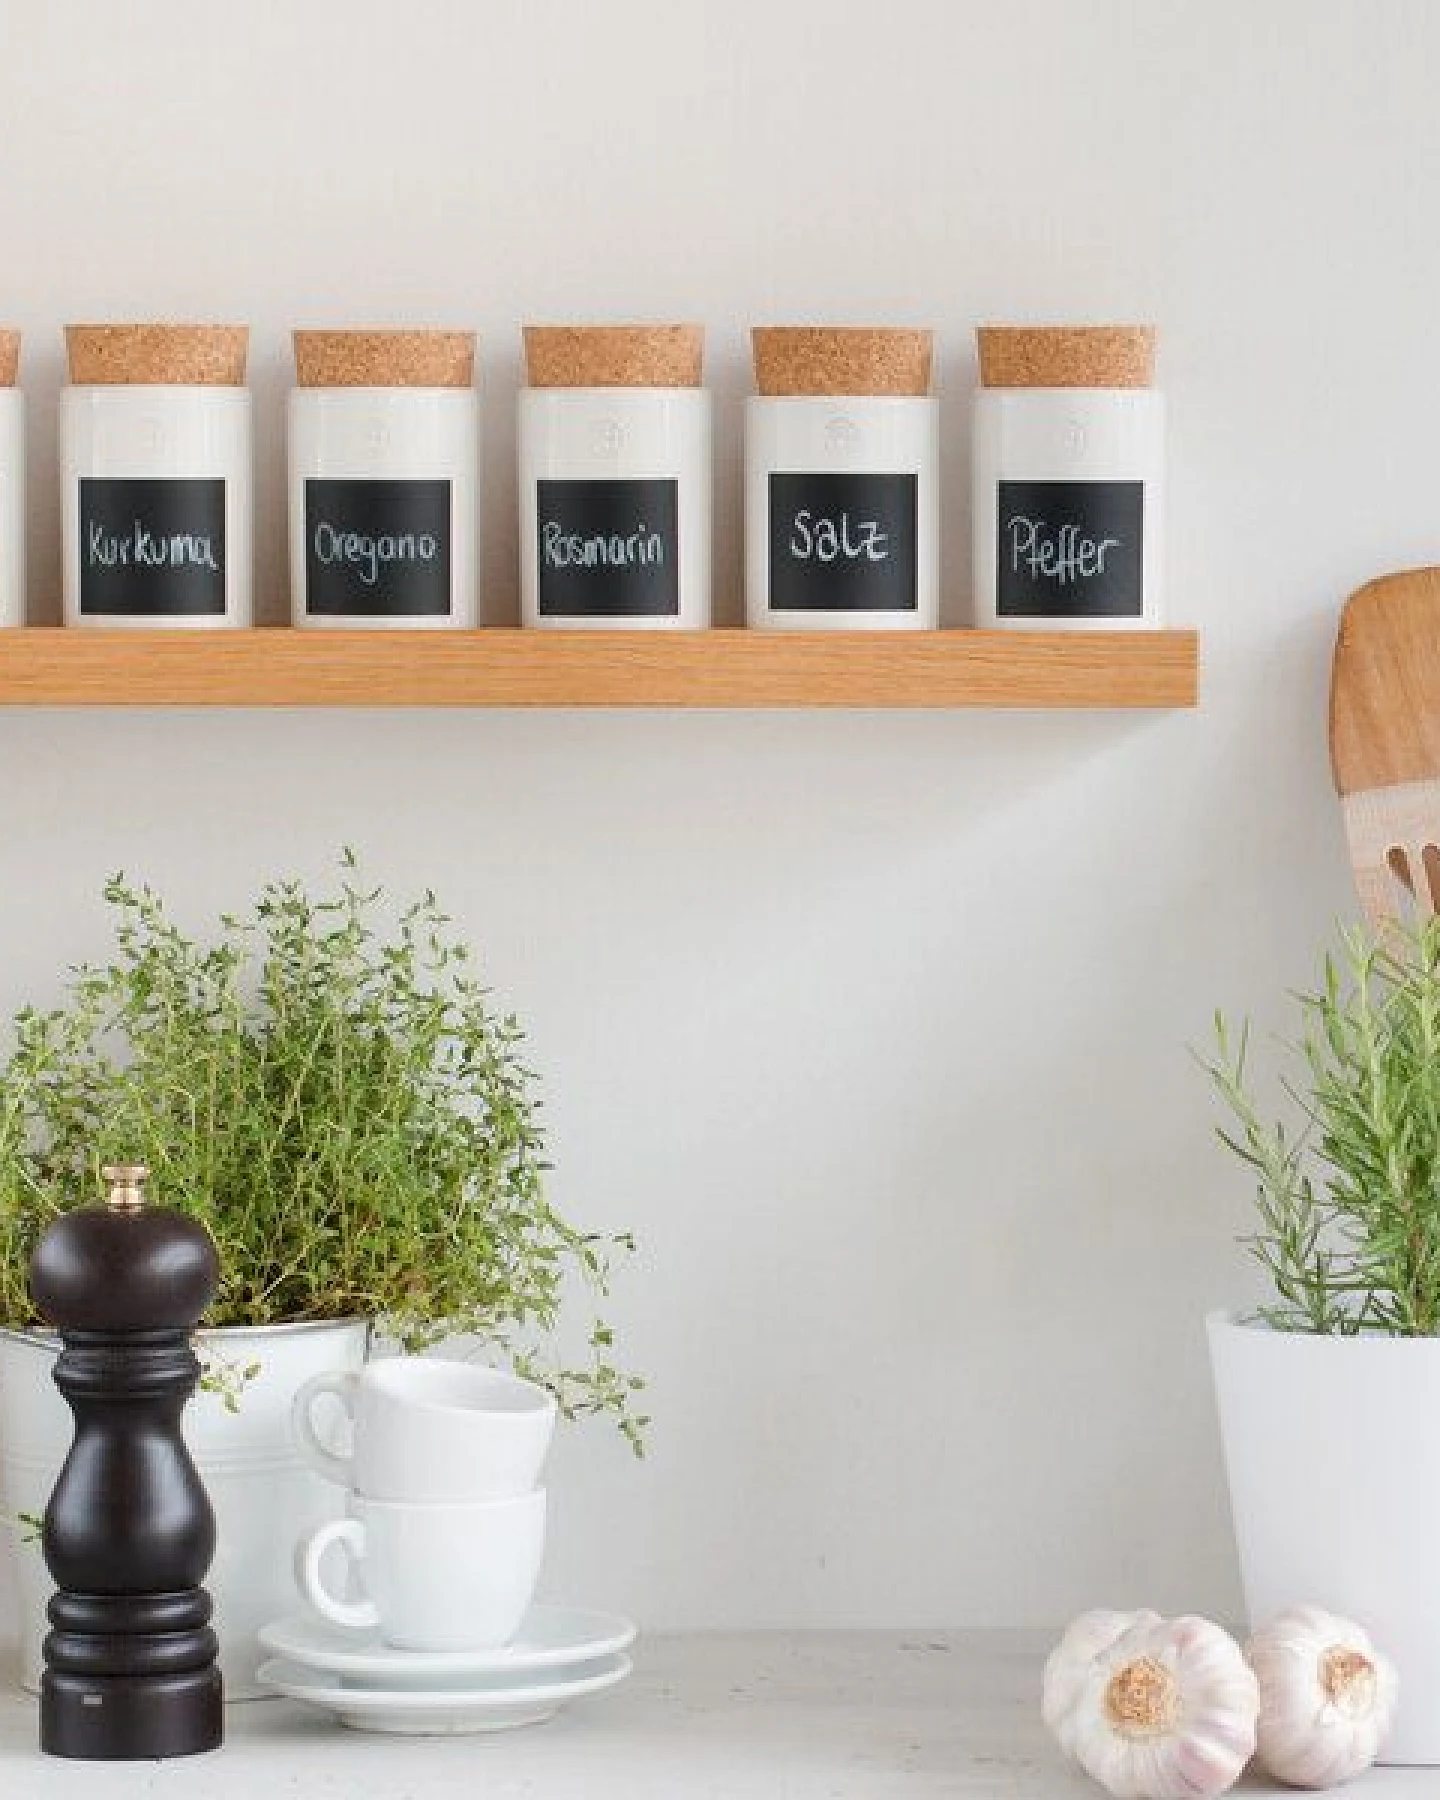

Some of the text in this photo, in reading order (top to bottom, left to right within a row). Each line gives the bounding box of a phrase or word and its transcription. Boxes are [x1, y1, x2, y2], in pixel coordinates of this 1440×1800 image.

[89, 519, 218, 570] Kurkuma
[314, 522, 437, 584] Oregano
[542, 522, 664, 568] Rosmarin
[790, 510, 890, 563] Salz
[1007, 516, 1120, 583] Pfeffer
